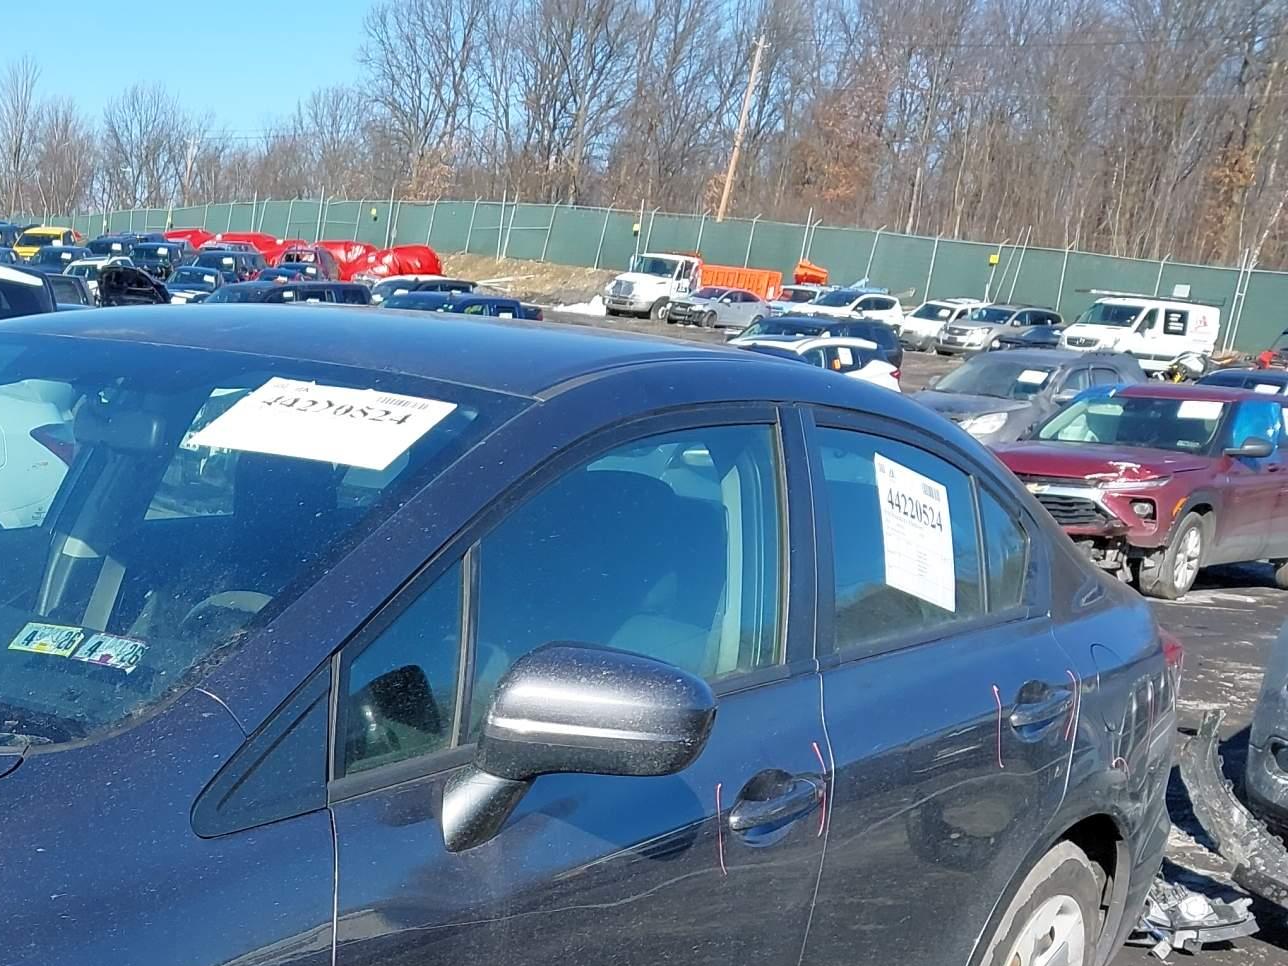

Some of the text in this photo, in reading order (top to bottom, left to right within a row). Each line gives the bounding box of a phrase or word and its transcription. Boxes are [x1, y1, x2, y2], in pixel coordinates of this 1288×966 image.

[261, 394, 413, 426] 44220524
[886, 486, 944, 533] 44220524
[23, 630, 82, 650] 4 26
[85, 640, 146, 665] 4 26
